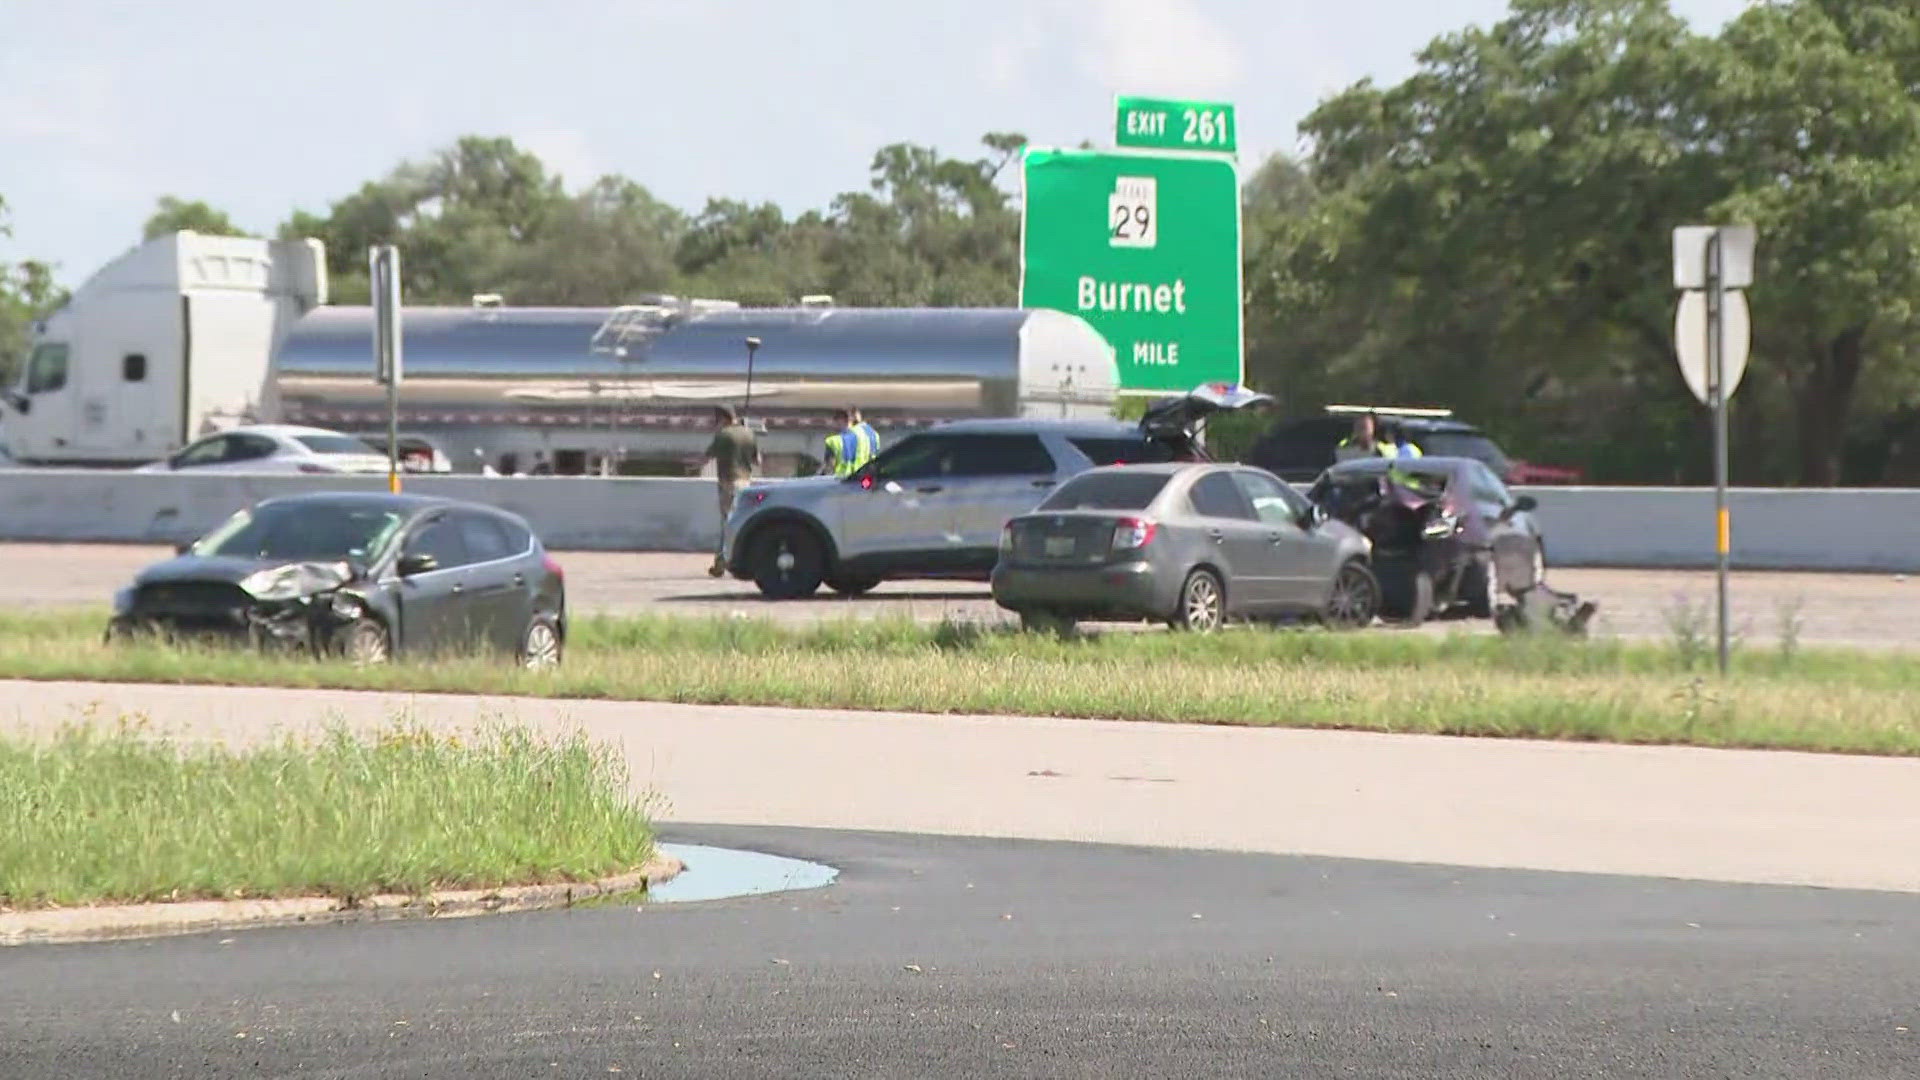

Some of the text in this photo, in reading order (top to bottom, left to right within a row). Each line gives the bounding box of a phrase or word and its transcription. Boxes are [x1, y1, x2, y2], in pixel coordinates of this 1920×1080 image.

[1127, 109, 1226, 145] EXIT 261
[1115, 205, 1149, 238] 29
[1079, 276, 1185, 314] Burnet
[1133, 341, 1179, 365] MILE
